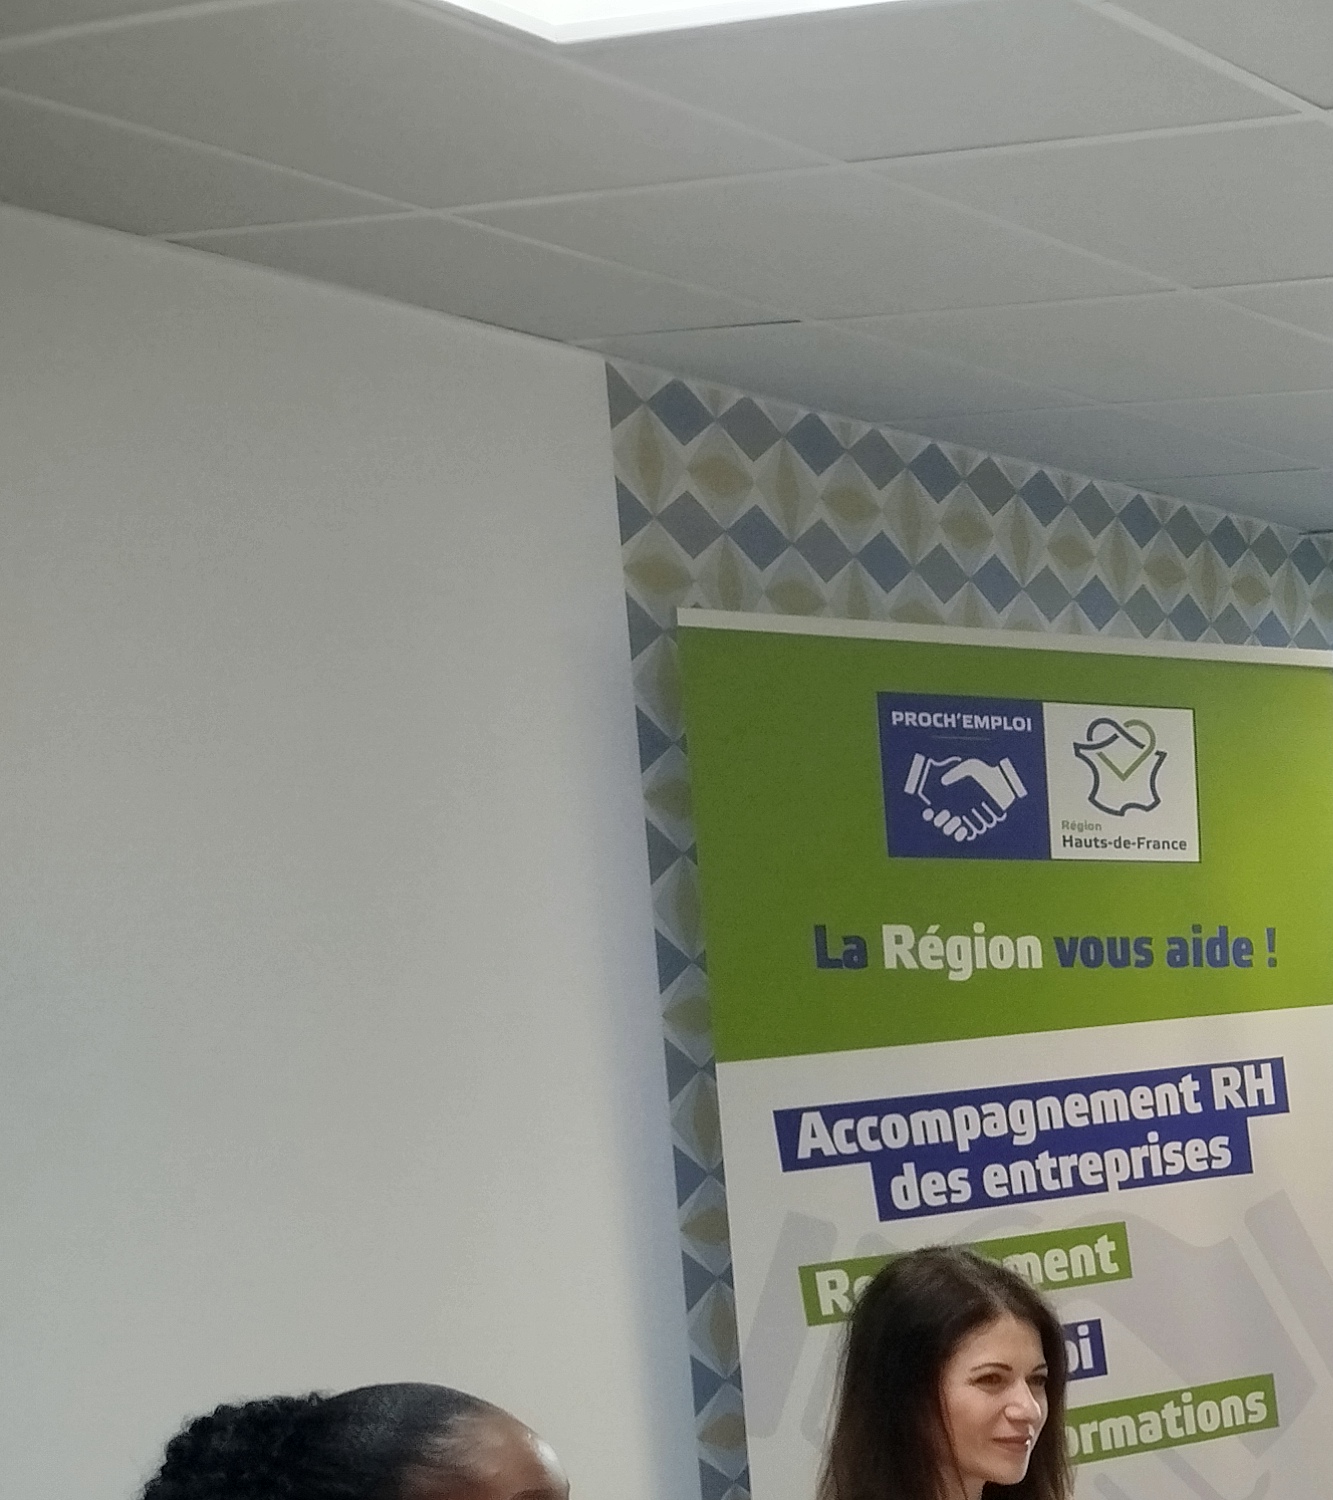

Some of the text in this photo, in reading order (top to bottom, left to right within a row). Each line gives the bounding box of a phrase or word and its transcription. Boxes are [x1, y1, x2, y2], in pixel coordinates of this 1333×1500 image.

[891, 710, 1032, 732] PROCH'EMPLOI
[1061, 819, 1102, 834] Région
[1062, 834, 1187, 850] Hauts-de-France
[813, 924, 868, 969] La
[882, 922, 1043, 981] Région
[1053, 928, 1154, 969] vous
[1165, 925, 1254, 969] aide
[796, 1062, 1276, 1159] Accompagnement RH
[890, 1133, 1232, 1211] des entreprises
